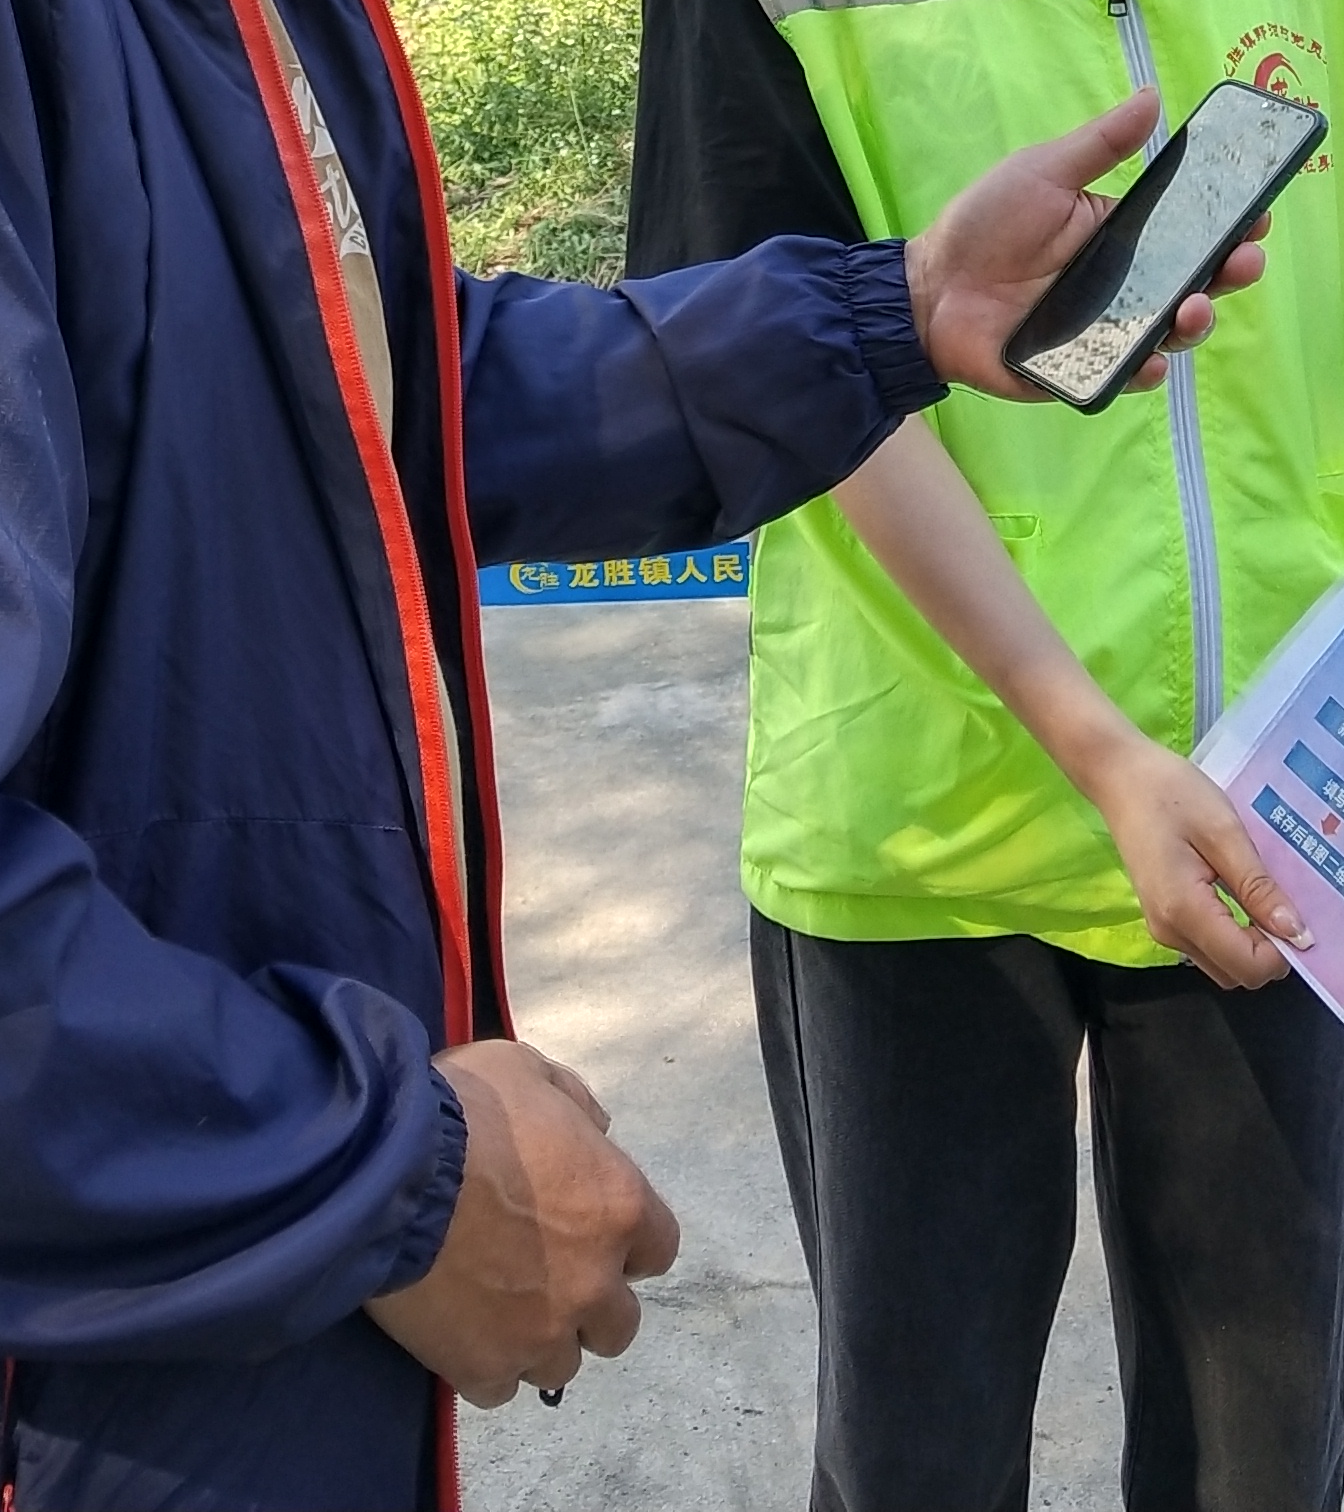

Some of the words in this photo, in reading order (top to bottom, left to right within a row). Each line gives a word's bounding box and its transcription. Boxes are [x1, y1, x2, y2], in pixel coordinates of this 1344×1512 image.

[568, 554, 751, 589] 龙胜镇人民
